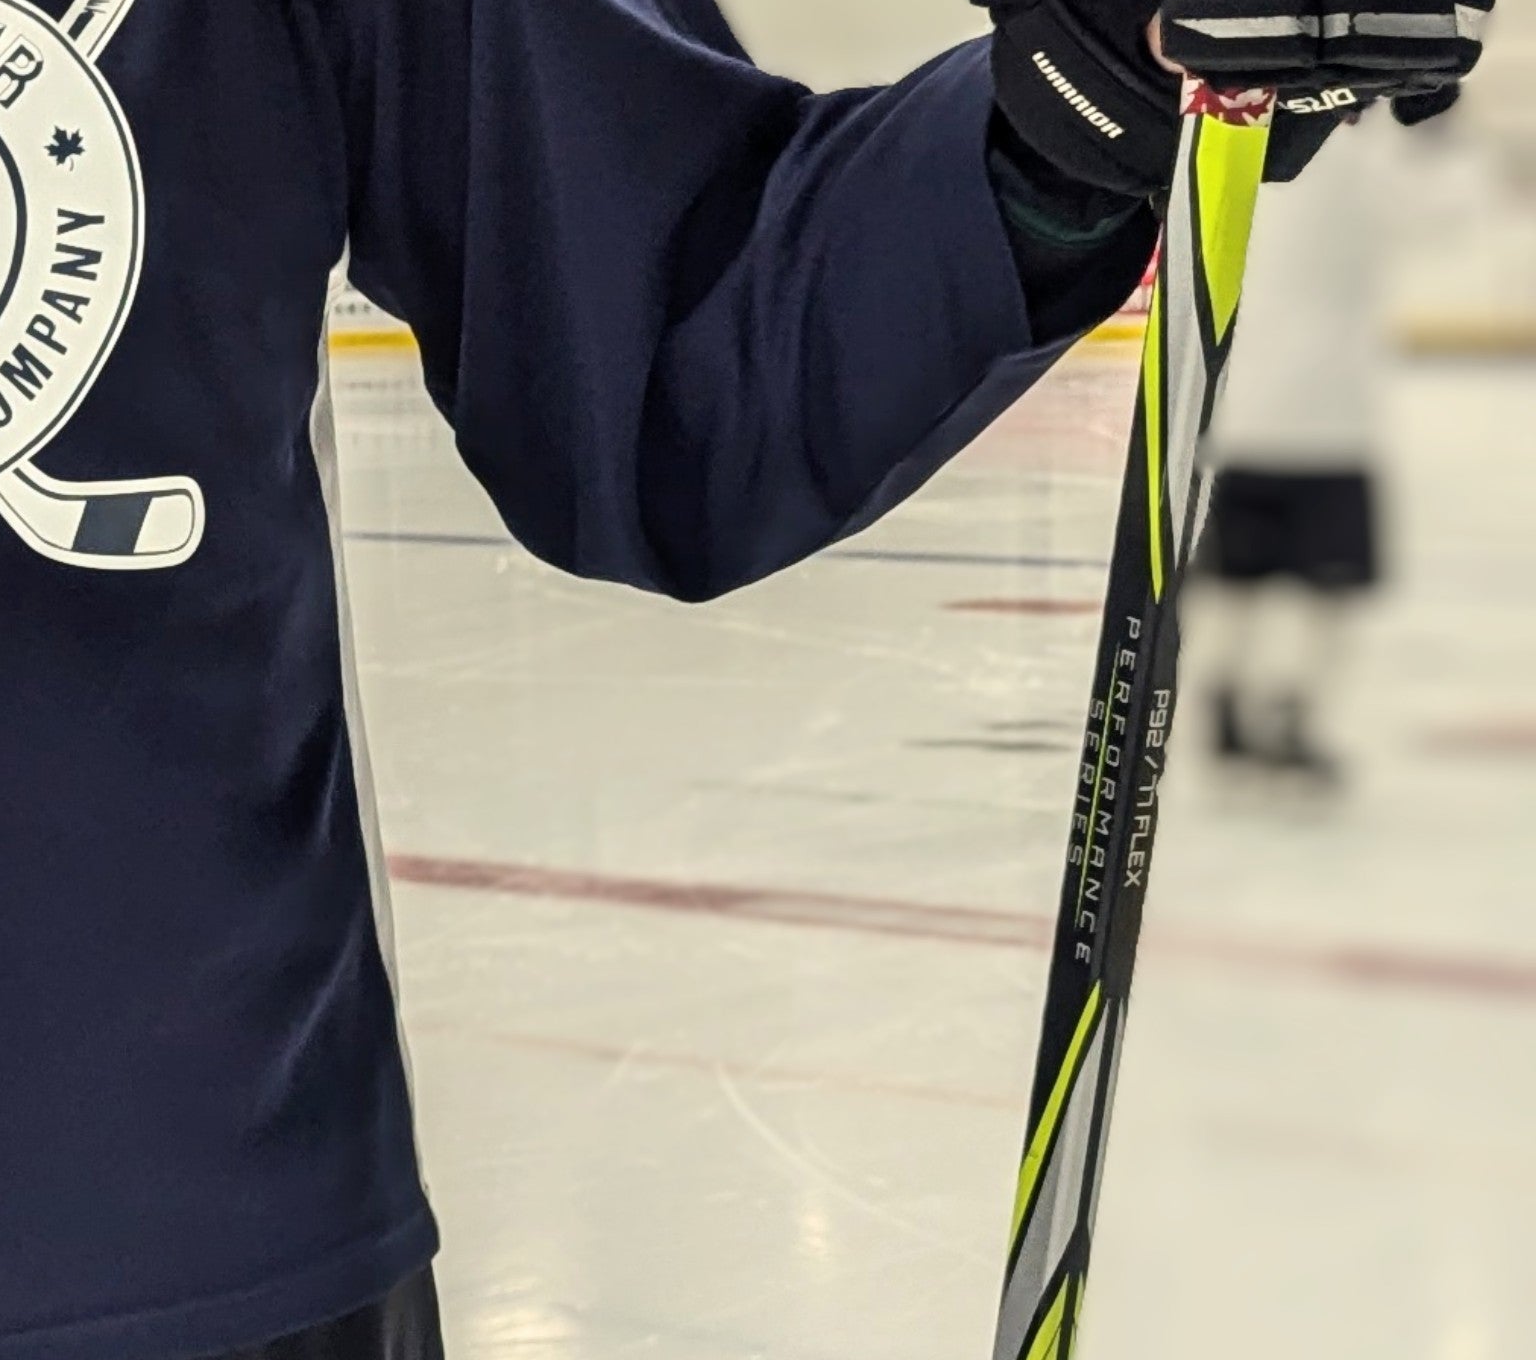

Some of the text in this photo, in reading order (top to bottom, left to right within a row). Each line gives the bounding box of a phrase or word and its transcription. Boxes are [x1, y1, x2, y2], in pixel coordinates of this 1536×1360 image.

[1031, 50, 1124, 139] WARRIOR
[1069, 697, 1105, 866] SERIES
[1075, 615, 1142, 965] PERFORMANCE
[1124, 814, 1151, 888] FLEX
